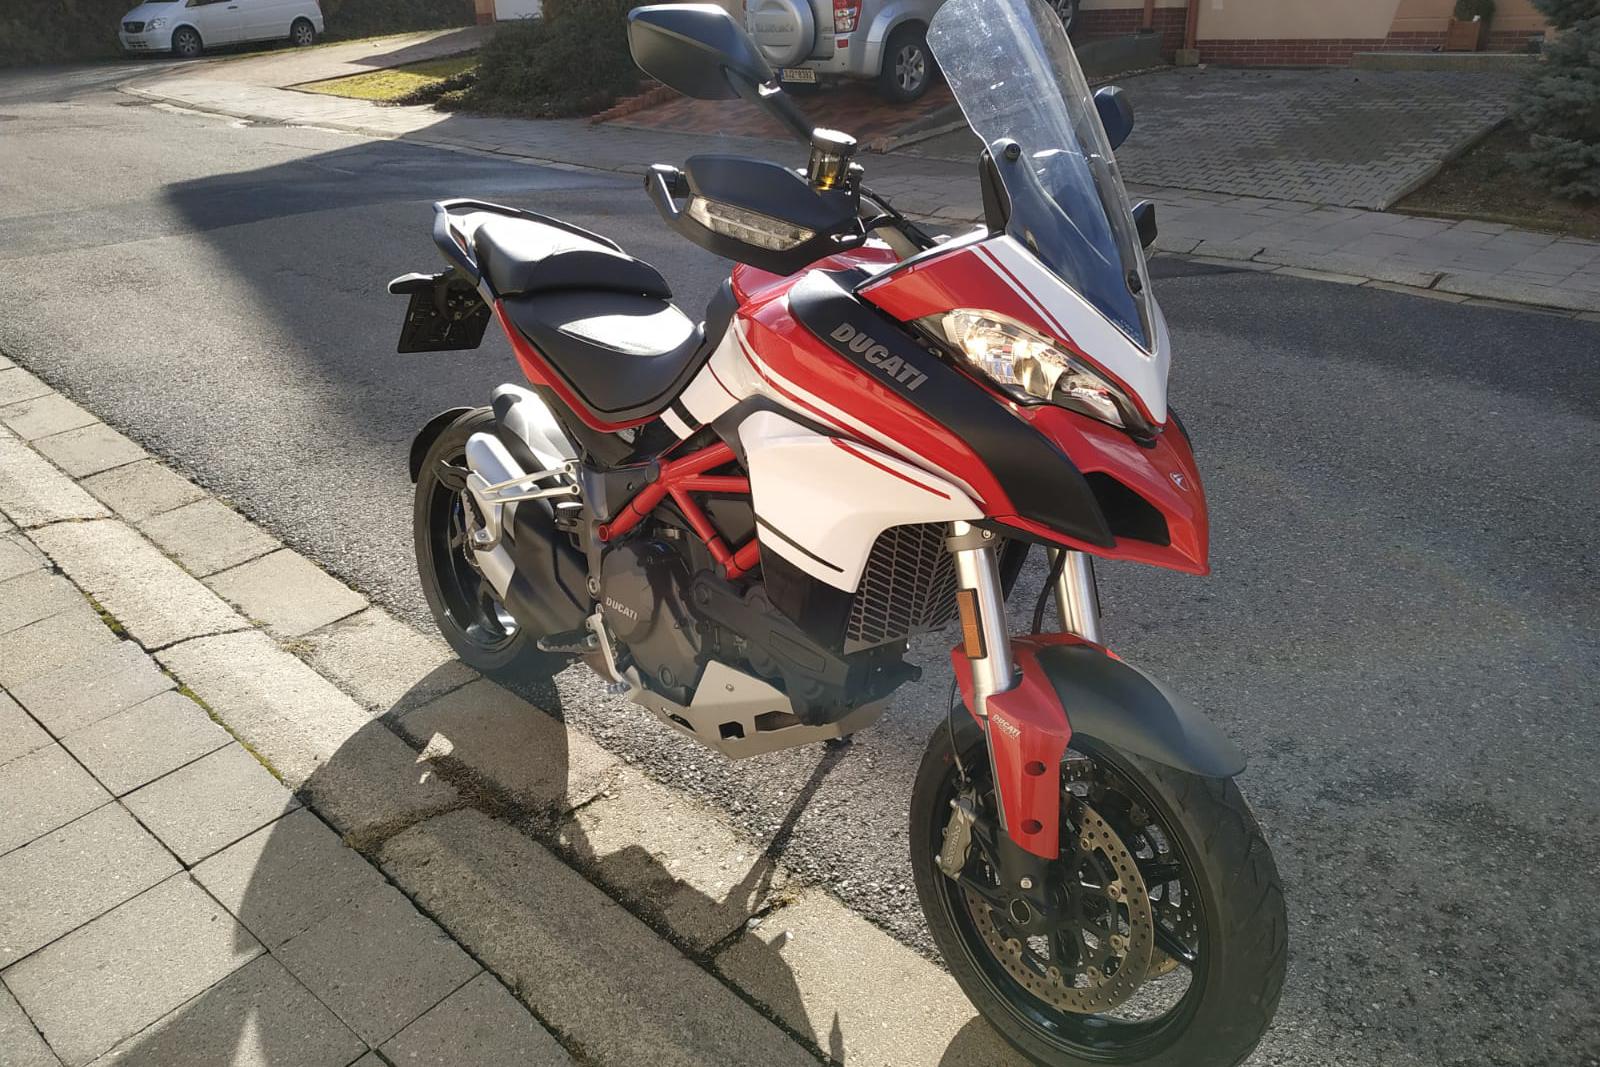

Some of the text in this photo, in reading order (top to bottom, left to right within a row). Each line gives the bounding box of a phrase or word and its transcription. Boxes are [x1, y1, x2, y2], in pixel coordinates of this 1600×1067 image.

[830, 322, 929, 391] DUCATI
[606, 596, 638, 621] DUCATI
[992, 713, 1021, 737] DUCATI
